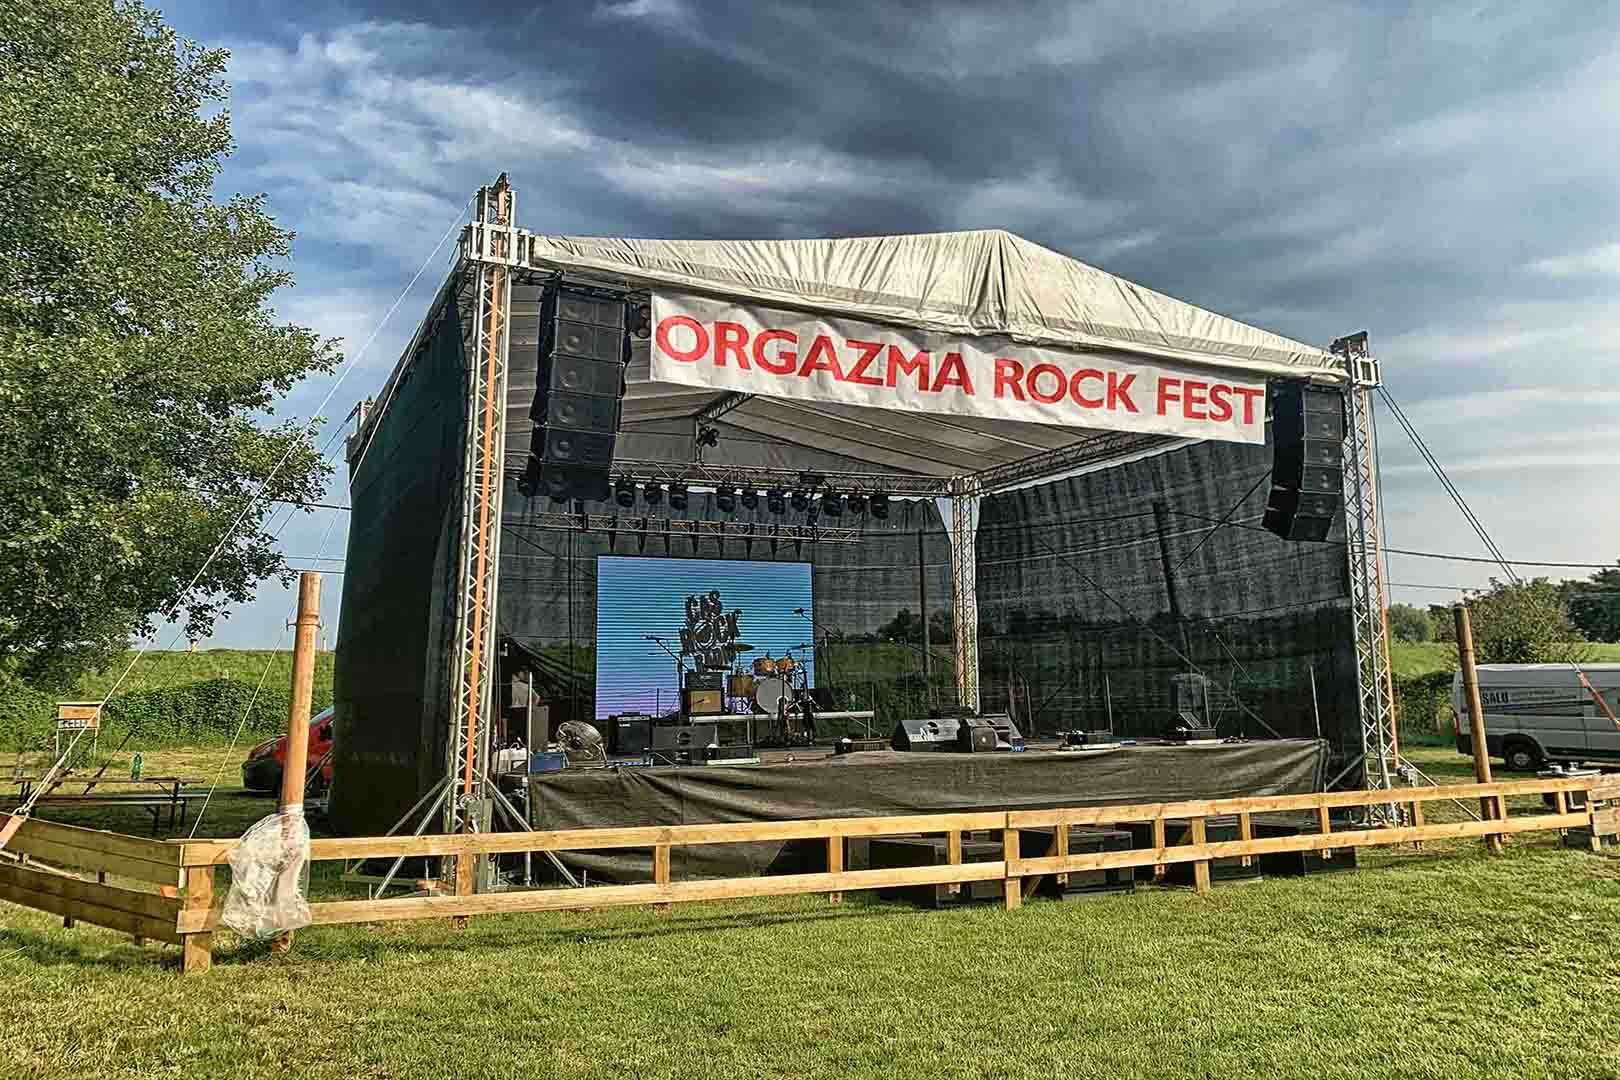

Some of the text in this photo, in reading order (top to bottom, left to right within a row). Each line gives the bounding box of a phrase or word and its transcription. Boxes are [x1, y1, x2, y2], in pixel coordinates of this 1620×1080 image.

[655, 314, 1265, 426] ORGAZMA ROCK FEST
